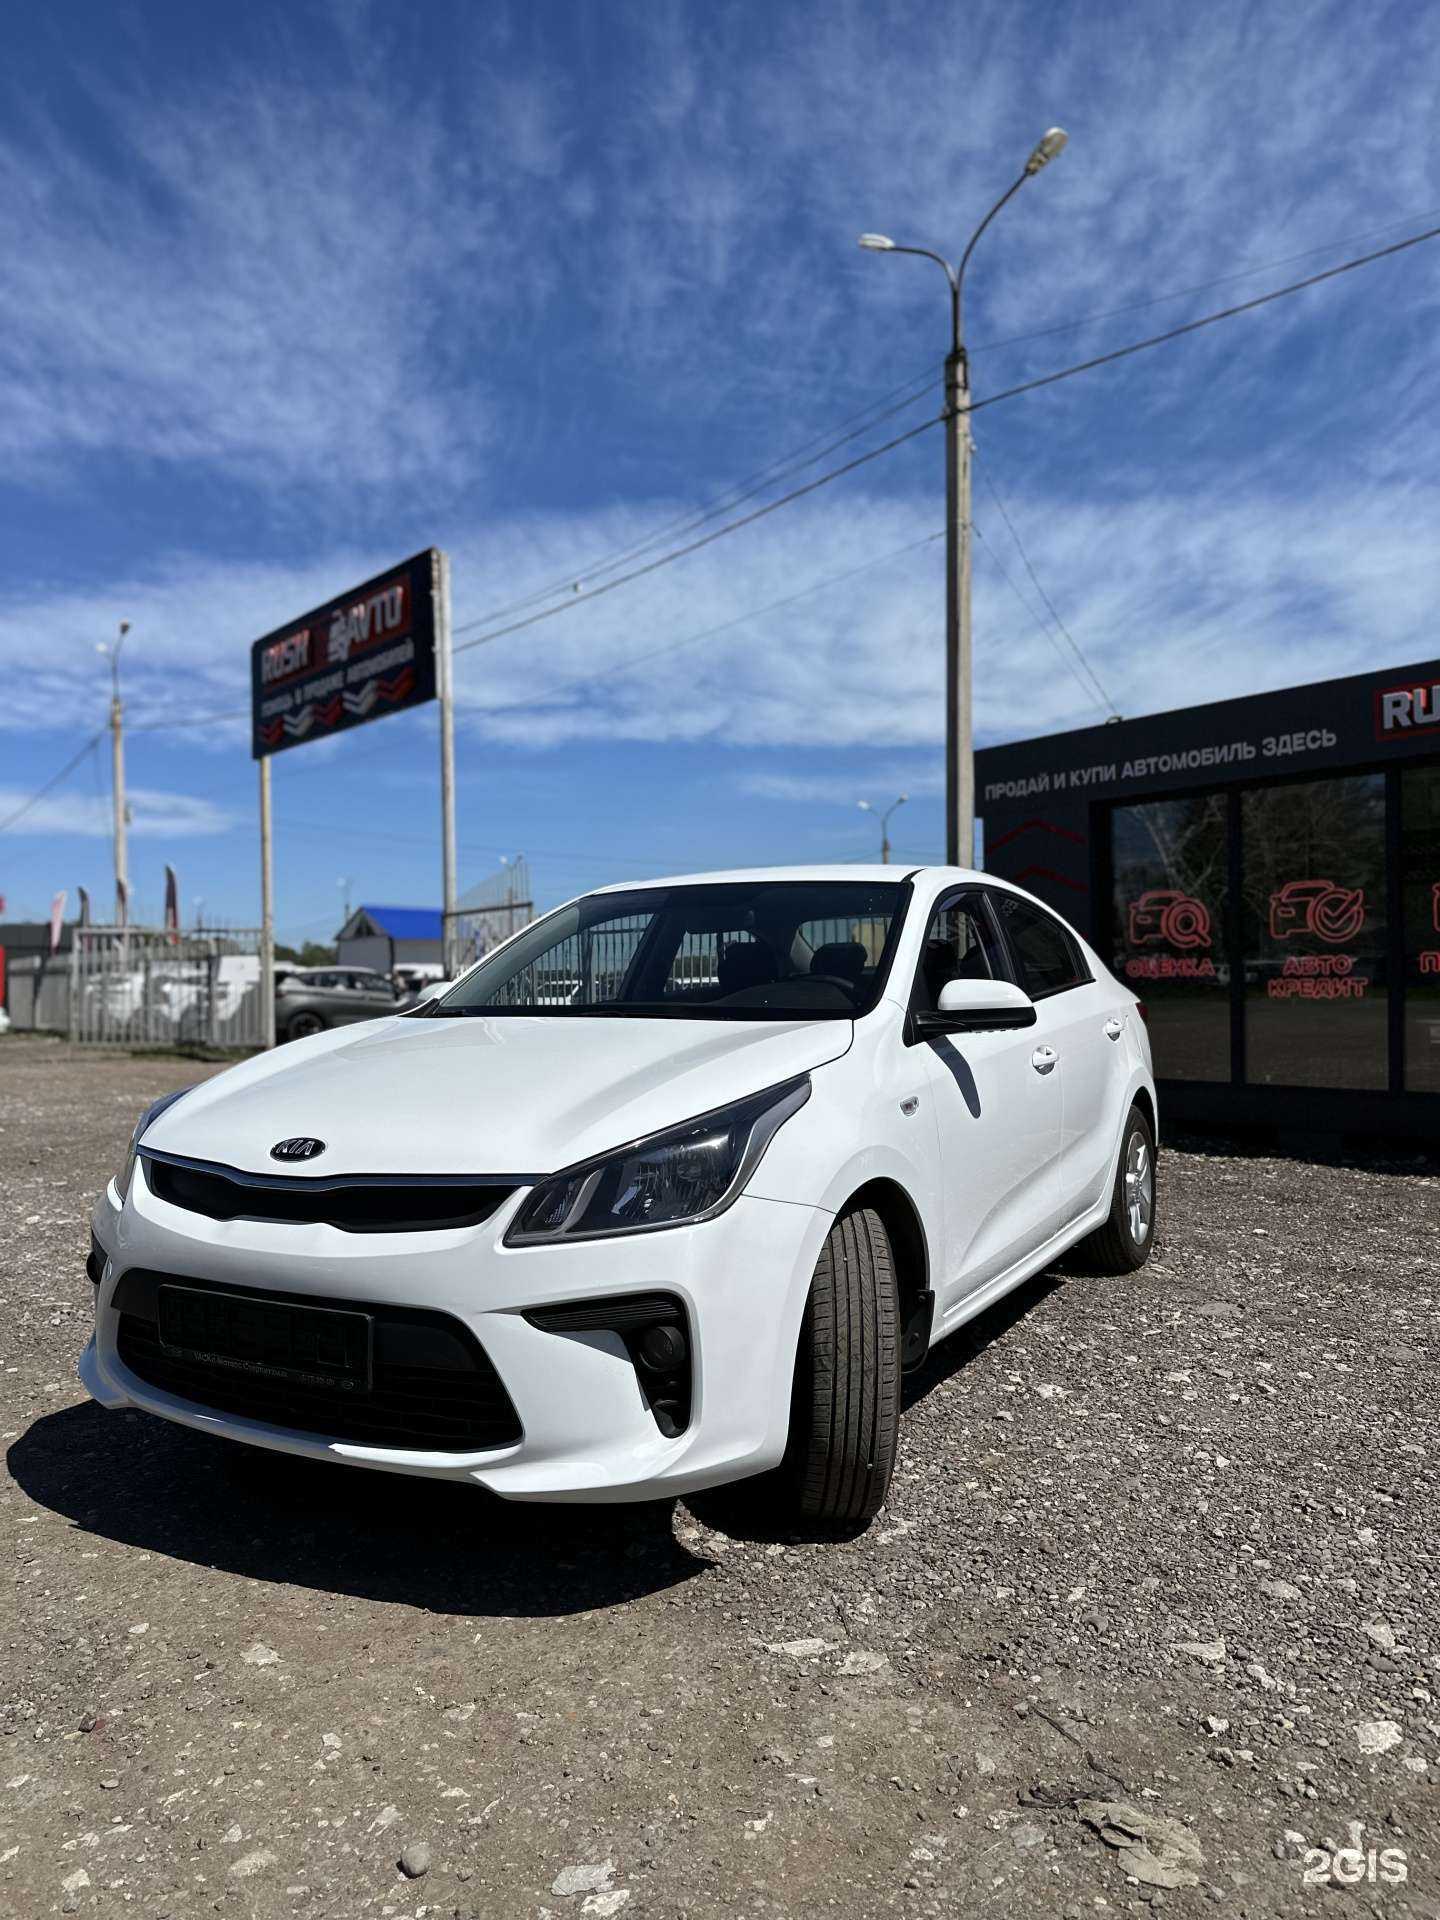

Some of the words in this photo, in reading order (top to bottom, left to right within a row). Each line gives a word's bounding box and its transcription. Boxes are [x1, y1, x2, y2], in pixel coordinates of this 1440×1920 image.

[984, 773, 1050, 800] ПРОДАЙ
[1053, 773, 1066, 790] И
[1070, 764, 1116, 787] КУПИ
[1121, 741, 1256, 779] АВТОМОБИЛЬ
[1261, 729, 1337, 756] ЗДЕСЬ
[1125, 956, 1216, 979] ОЦЕНКА
[1282, 954, 1353, 976] АВТО
[1267, 976, 1369, 1000] КРЕДИТ
[275, 1139, 316, 1156] KIA
